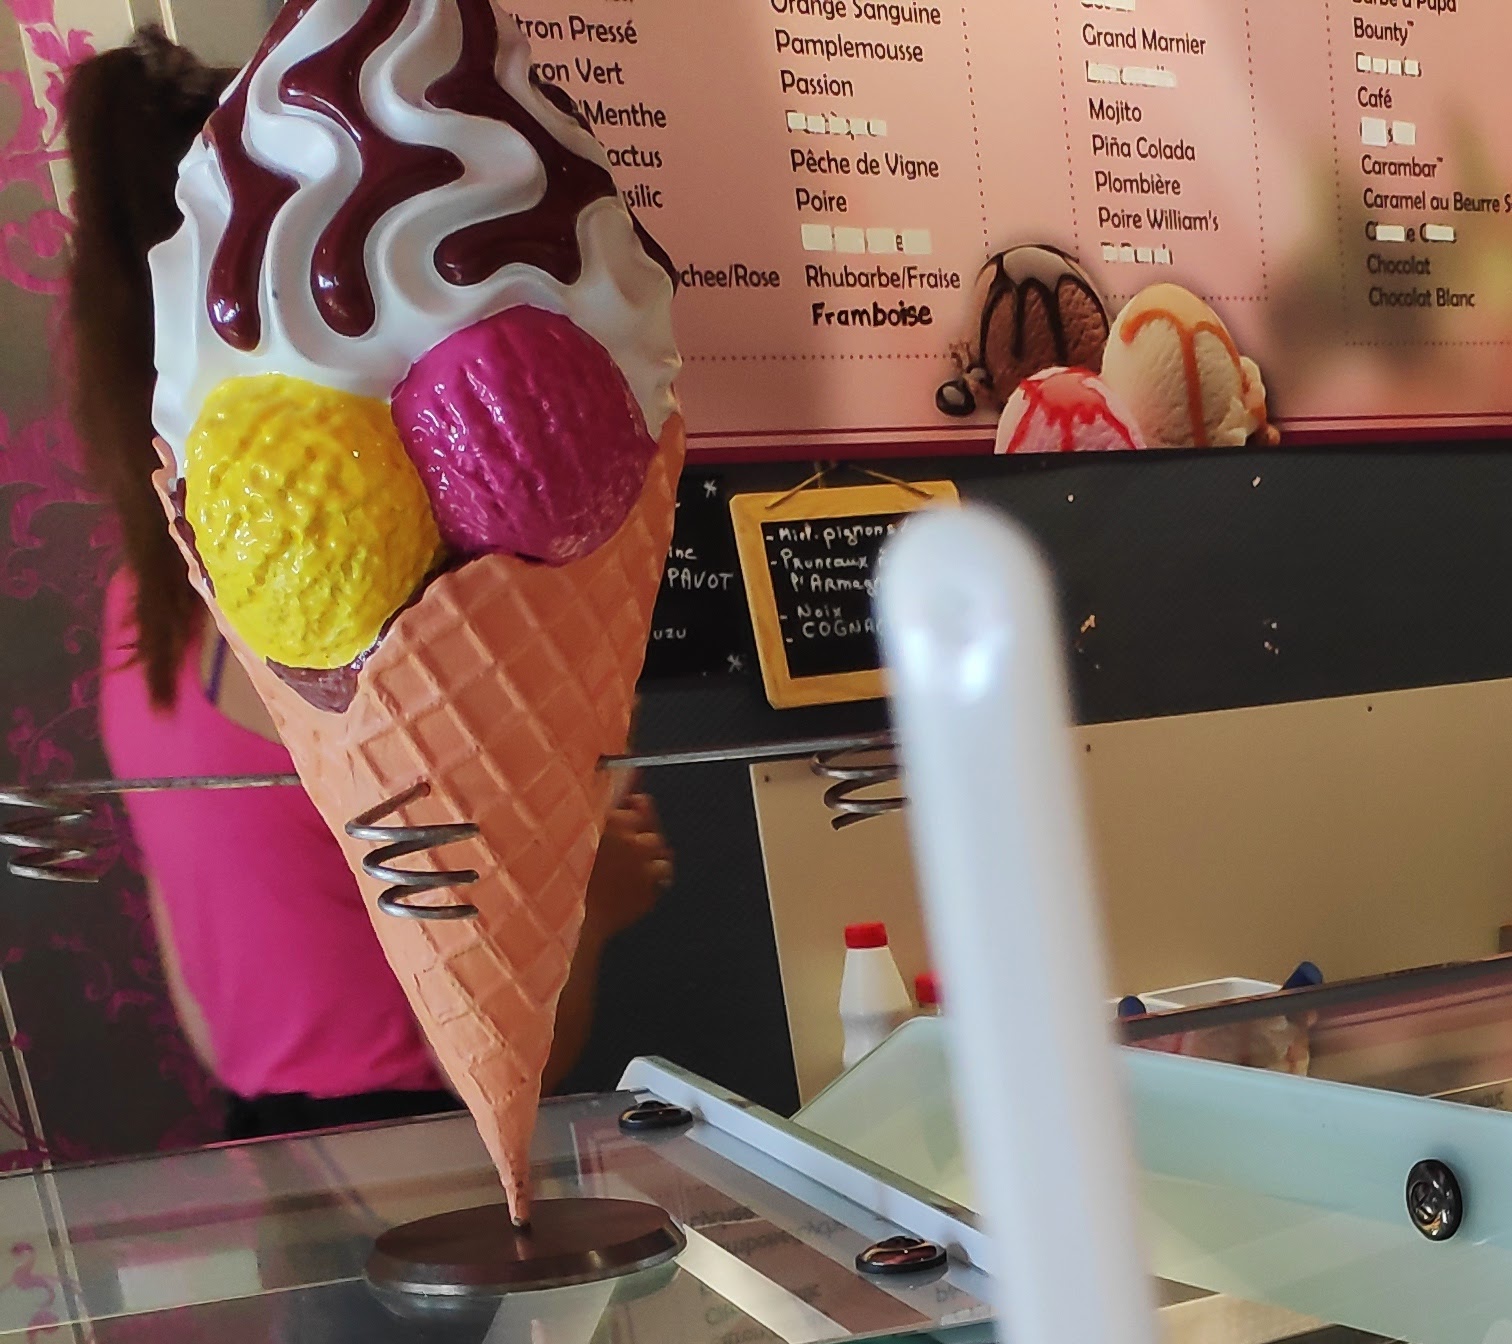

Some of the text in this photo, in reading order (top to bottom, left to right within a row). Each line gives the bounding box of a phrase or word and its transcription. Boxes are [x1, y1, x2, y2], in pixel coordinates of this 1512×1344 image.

[853, 0, 941, 25] Sanguine
[509, 14, 638, 44] tron Pressé
[1082, 23, 1207, 55] Grand Marnier
[775, 28, 924, 62] Pamplemousse
[575, 57, 624, 85] Vert
[780, 69, 854, 97] Passion
[1357, 86, 1393, 109] Café
[579, 99, 667, 128] Menthe
[1088, 97, 1142, 125] Mojito
[1092, 134, 1196, 161] Piña Colada
[790, 148, 939, 180] Pêche de Vigne
[1095, 170, 1181, 195] Plombière
[795, 187, 847, 212] Poire
[1363, 187, 1426, 210] Caramel
[1430, 196, 1449, 211] au
[1453, 191, 1500, 213] Beurre
[1098, 206, 1219, 231] Poire William's
[677, 264, 780, 288] chee/Rose
[805, 265, 961, 289] Rhubarbe/Fraise
[1367, 253, 1431, 275] Chocolat
[1369, 287, 1476, 308] Chocolat Blanc
[812, 300, 933, 327] Framboise
[667, 567, 734, 591] PAVOT
